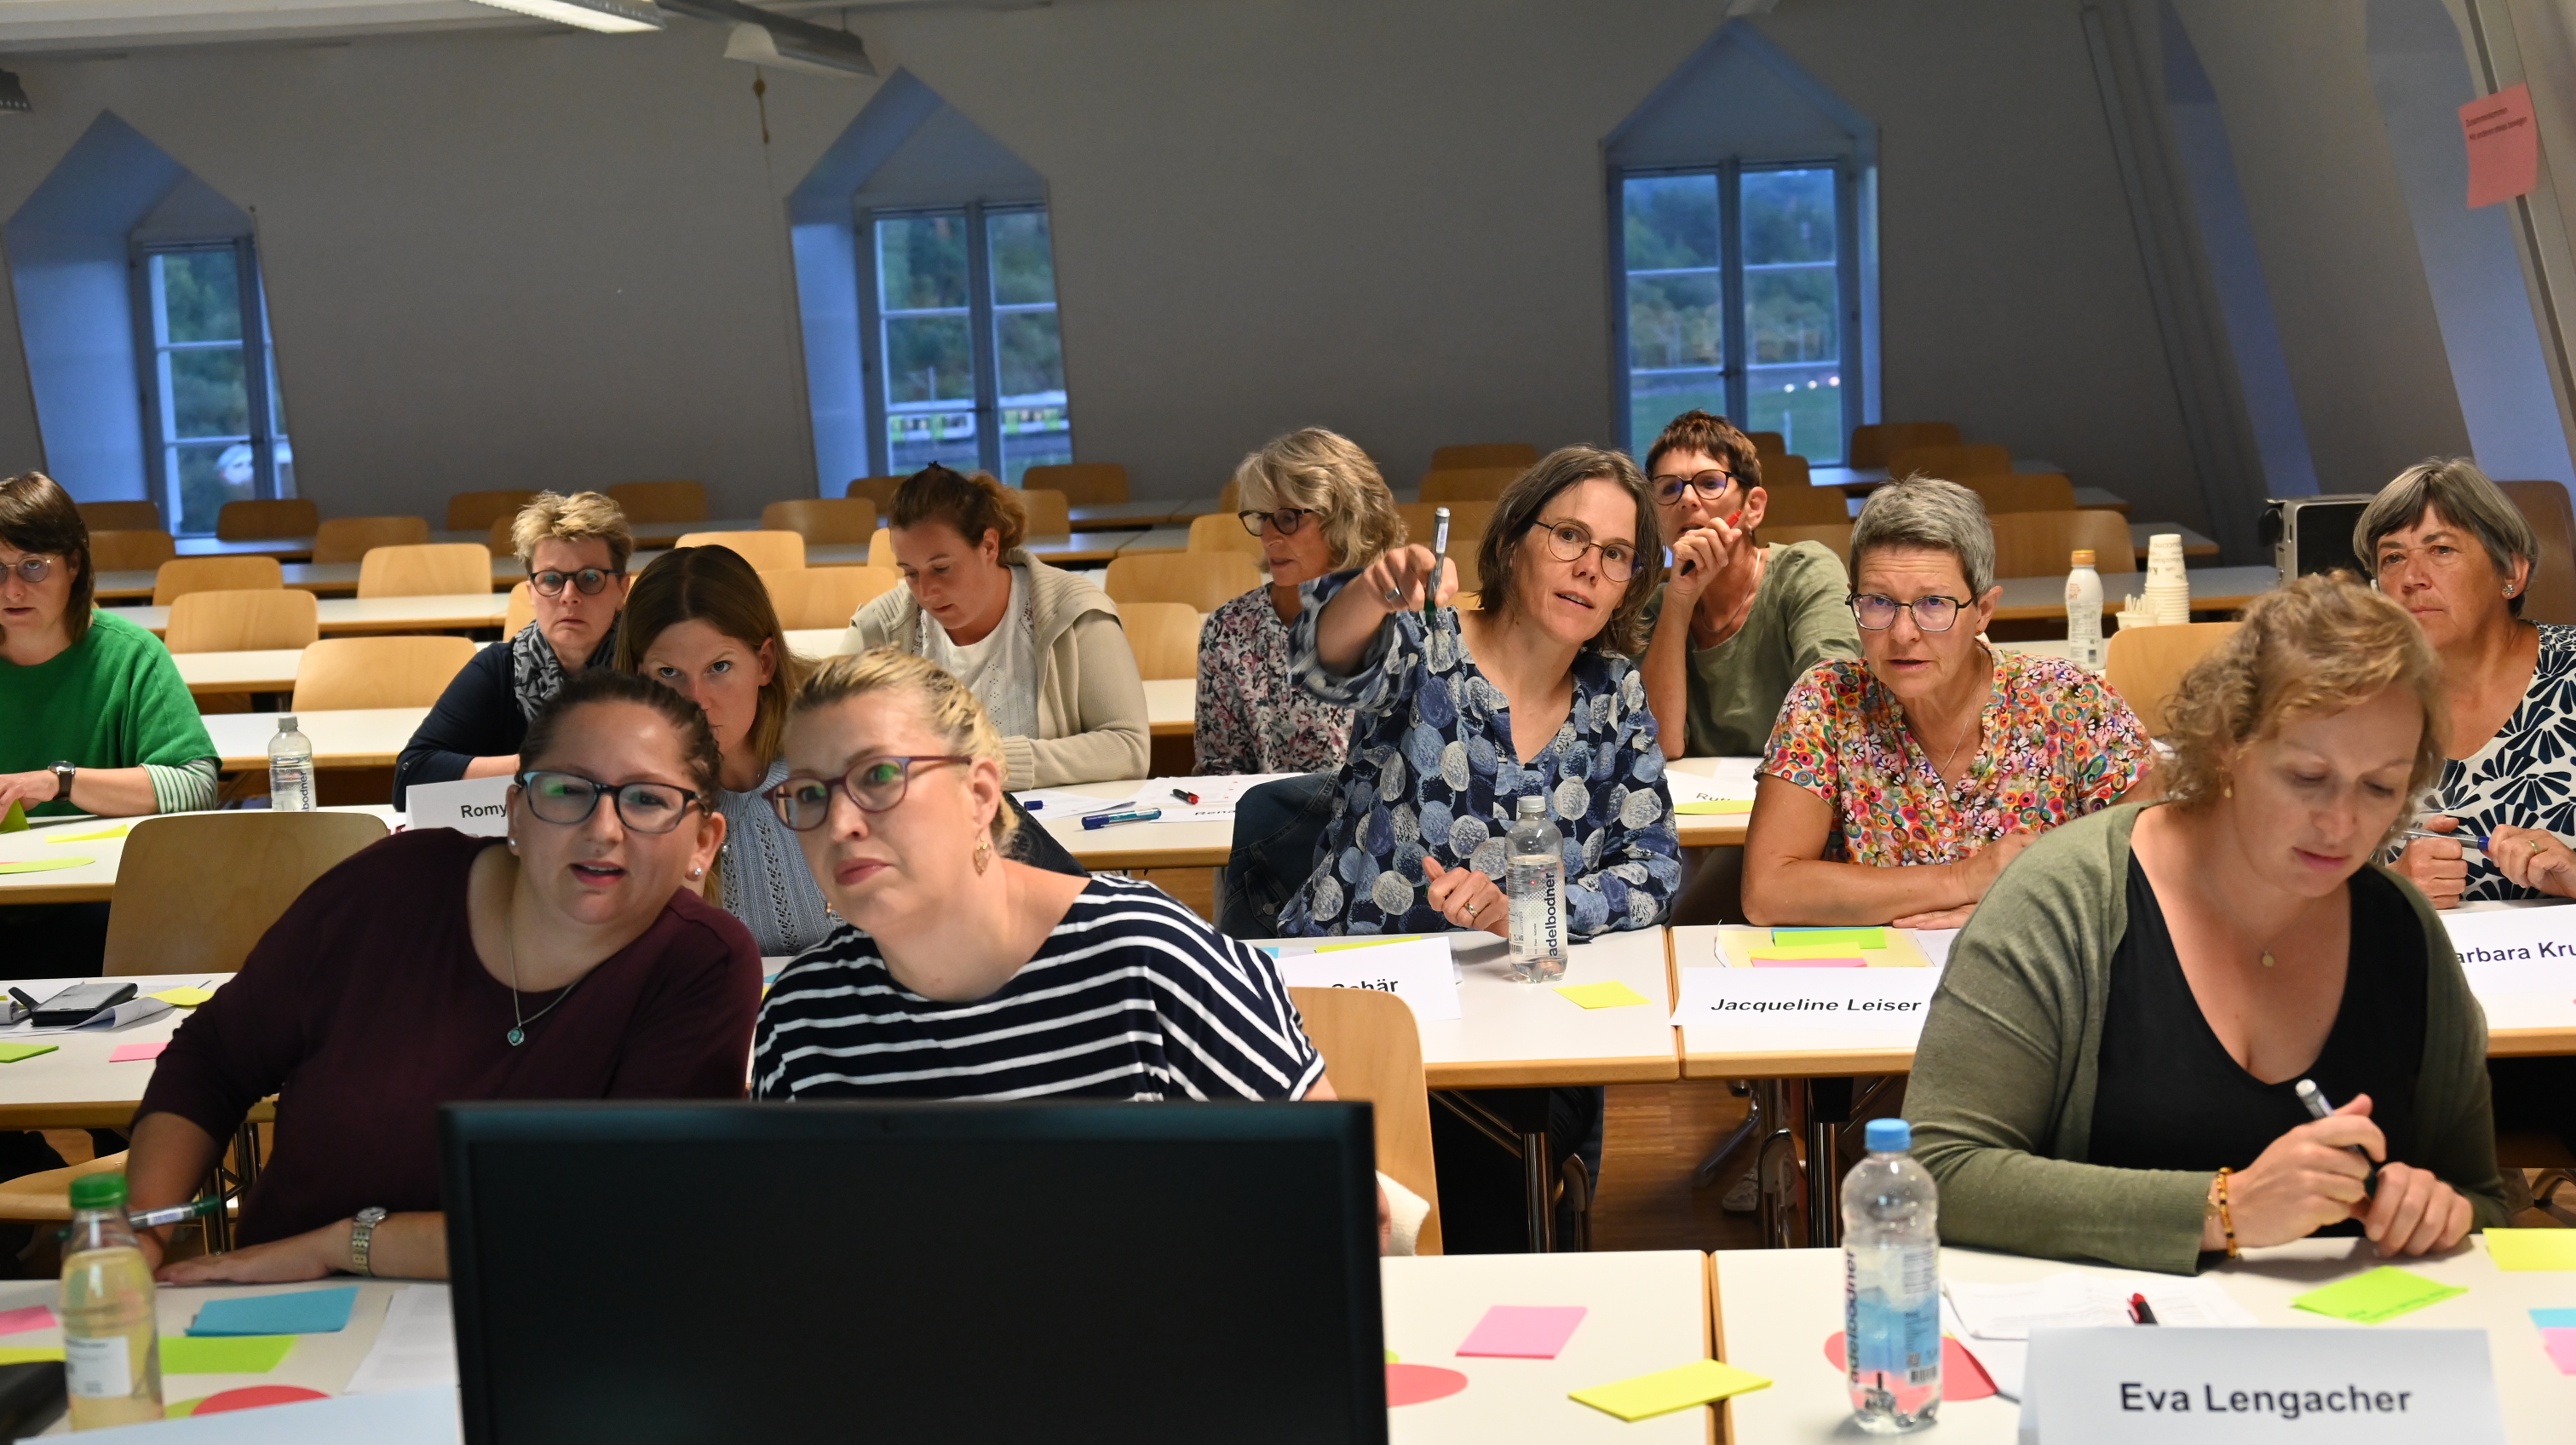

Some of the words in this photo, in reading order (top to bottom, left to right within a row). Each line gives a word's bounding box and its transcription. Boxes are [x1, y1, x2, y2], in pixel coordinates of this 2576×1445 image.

[461, 804, 506, 818] Romy
[1545, 872, 1558, 956] adelbodner
[1331, 978, 1398, 993] här
[1711, 999, 1839, 1013] Jacqueline
[1848, 999, 1922, 1011] Leiser
[2120, 1382, 2191, 1413] Eva
[2205, 1382, 2413, 1420] Lengacher
